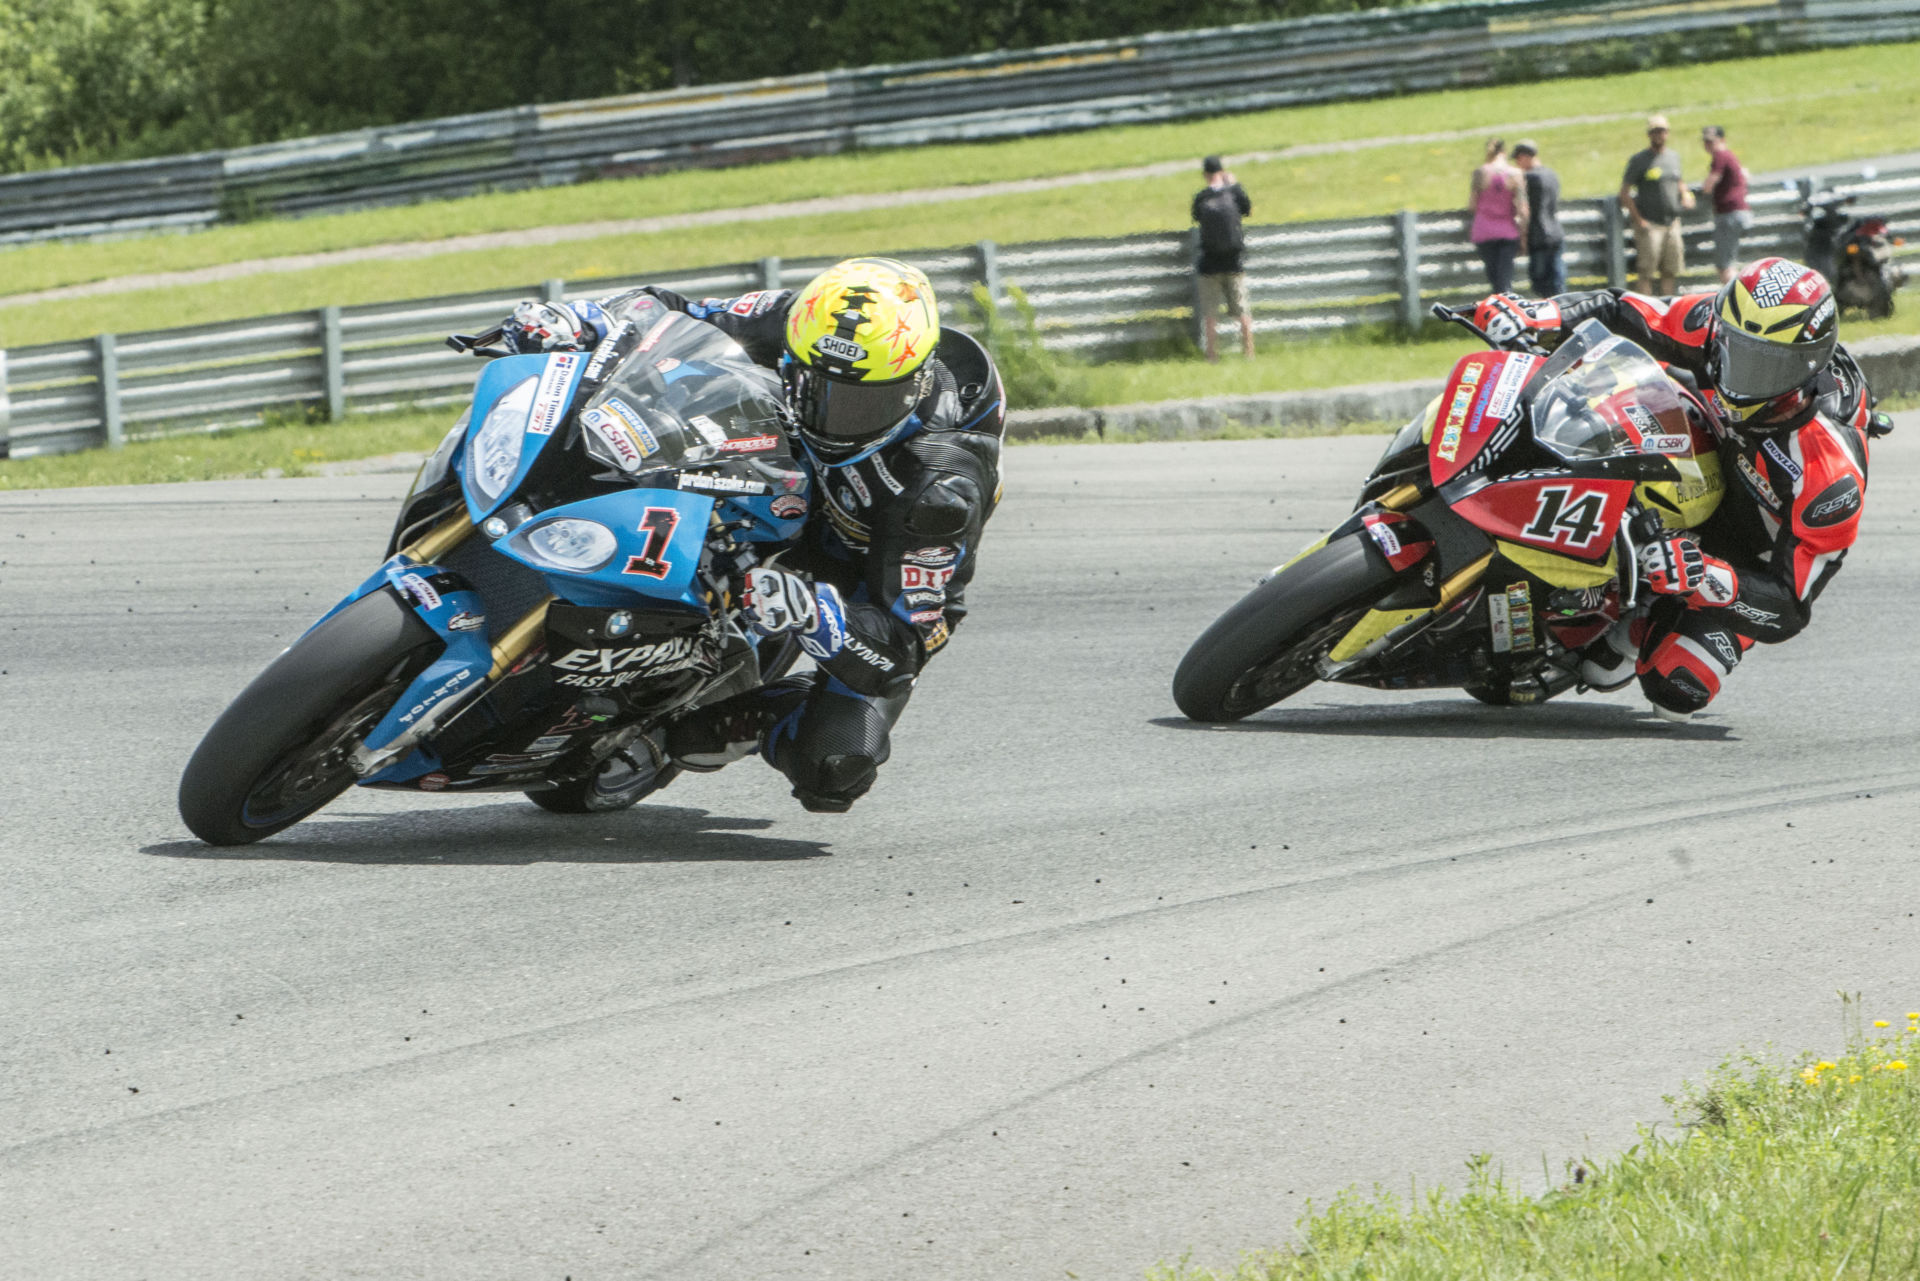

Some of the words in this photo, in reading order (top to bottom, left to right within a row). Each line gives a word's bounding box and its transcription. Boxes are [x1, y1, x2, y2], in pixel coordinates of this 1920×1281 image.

[823, 337, 858, 358] SHOEI
[552, 369, 570, 398] Dalton
[1461, 362, 1484, 385] THE
[1510, 363, 1527, 387] Dalton
[542, 399, 561, 433] Timmis
[1500, 388, 1517, 417] Timmis
[1437, 384, 1476, 463] PHARMACIST
[600, 423, 638, 463] CSBK
[1657, 438, 1686, 450] CSBK
[1766, 440, 1801, 478] DUNLOP
[1520, 485, 1609, 548] 14
[1812, 487, 1858, 518] RST
[622, 507, 681, 580] 1
[1384, 529, 1399, 553] CSBK
[418, 582, 438, 606] CSBK
[1728, 600, 1781, 622] RST
[555, 673, 615, 688] FAST
[398, 669, 471, 723] DUNLOP
